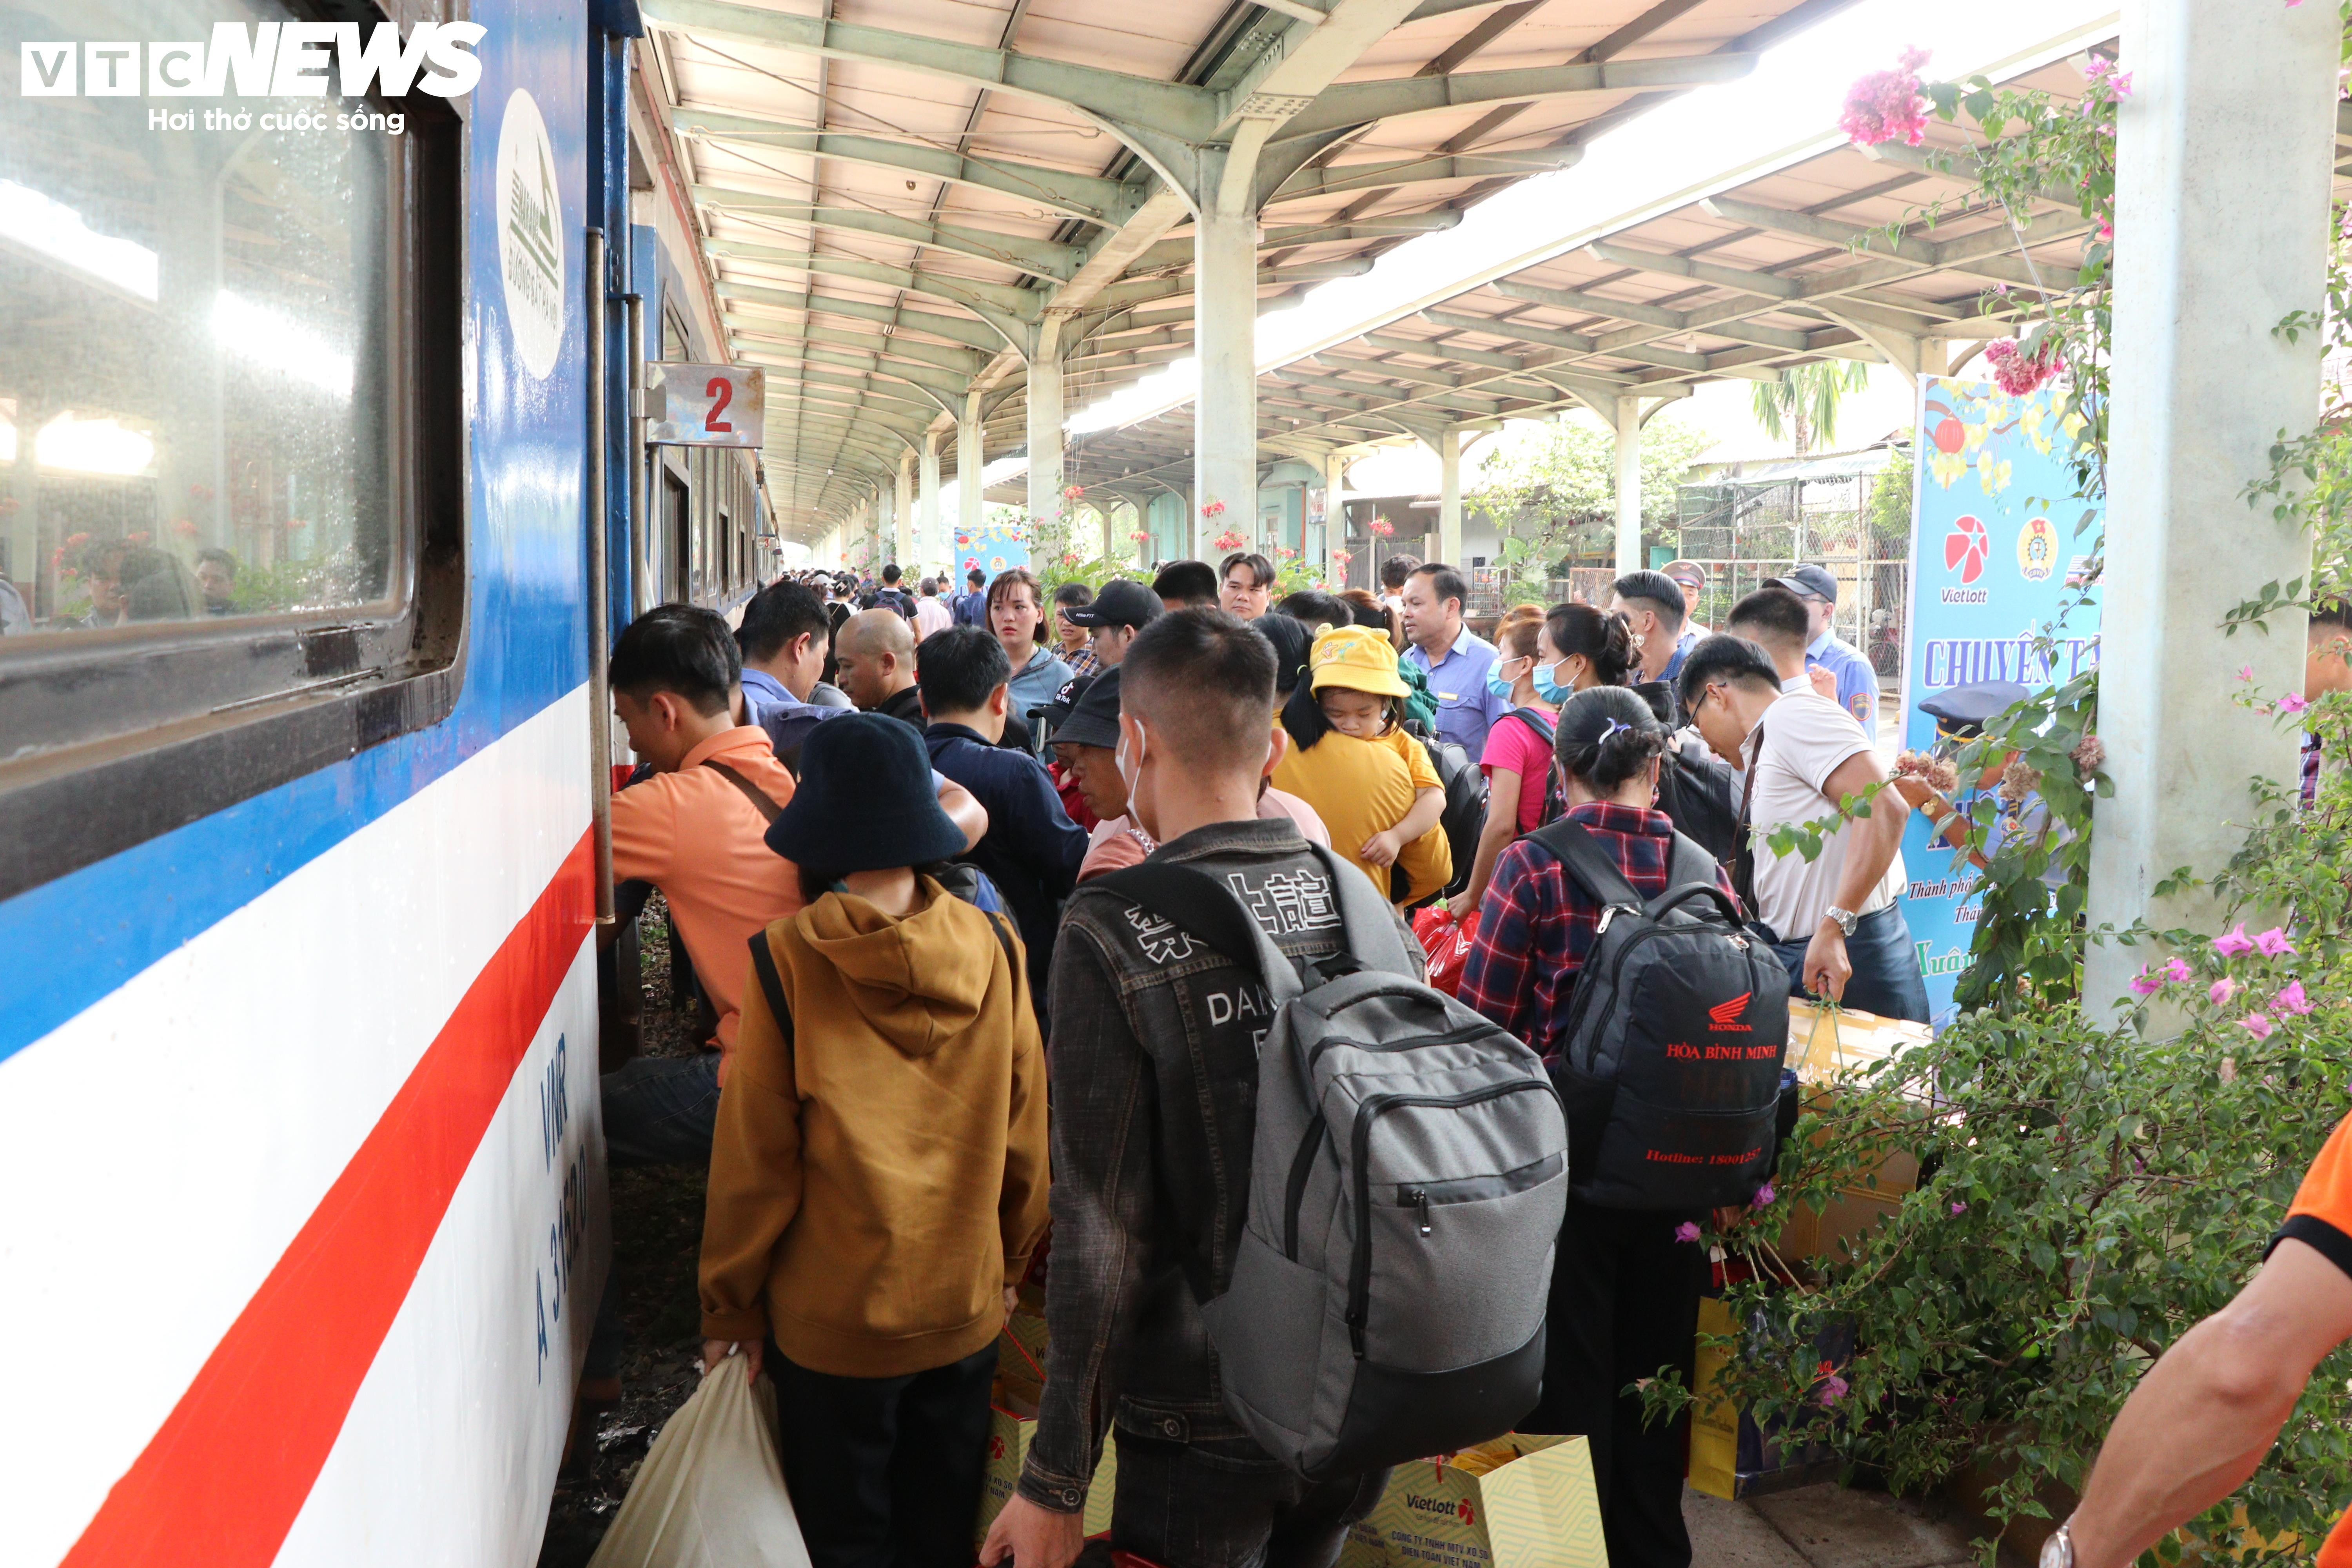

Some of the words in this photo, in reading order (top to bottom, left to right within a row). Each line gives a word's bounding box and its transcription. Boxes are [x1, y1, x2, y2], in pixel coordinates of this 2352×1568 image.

[705, 377, 732, 432] 2
[764, 538, 769, 548] 3
[1941, 588, 1988, 604] Vietlott
[1925, 621, 2052, 686] CHUYẾN
[1055, 693, 1071, 704] TikTok
[1908, 879, 1947, 899] Thành
[1708, 1023, 1752, 1032] HONDA
[1666, 1042, 1700, 1059] HÒA
[1705, 1043, 1741, 1060] BÌNH
[1745, 1045, 1777, 1060] MINH
[541, 1032, 568, 1175] VNR
[1646, 1149, 1703, 1164] Hotline:
[536, 1267, 548, 1387] A
[551, 1144, 587, 1322] 31520
[1406, 1493, 1455, 1516] Vietlott
